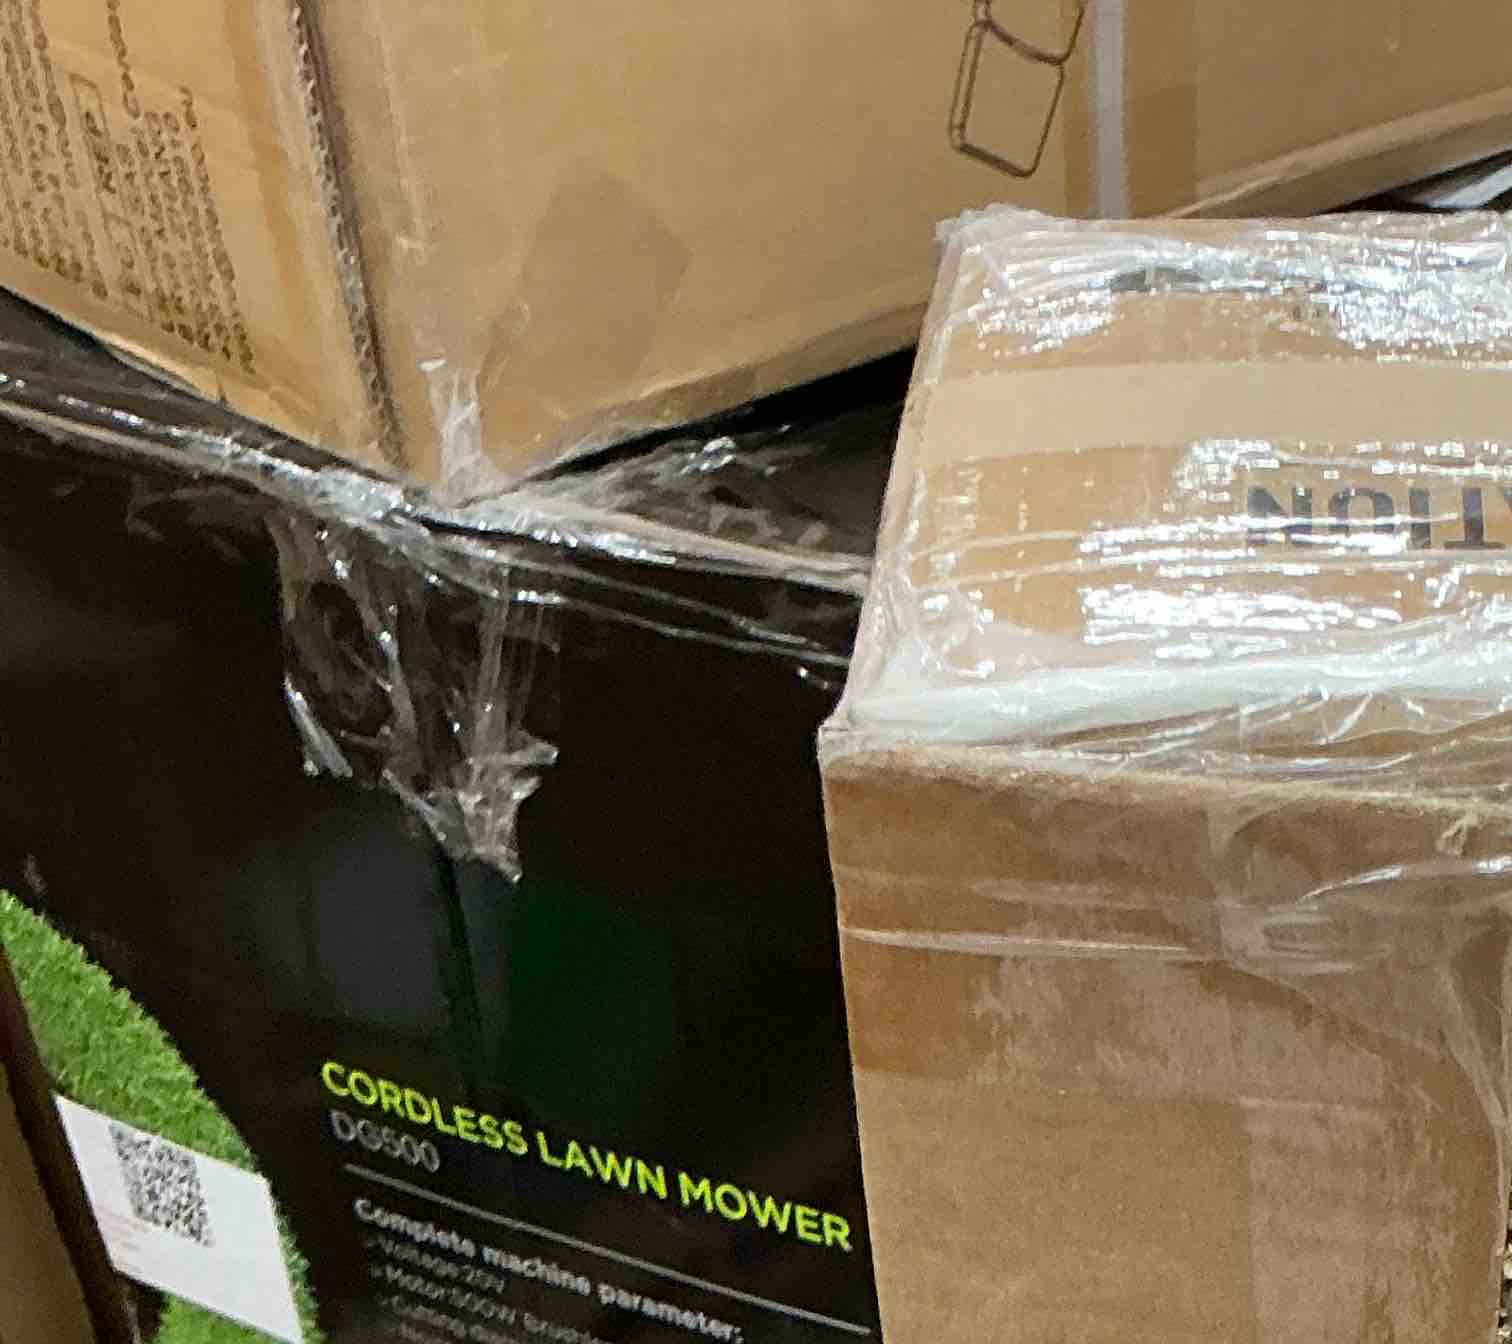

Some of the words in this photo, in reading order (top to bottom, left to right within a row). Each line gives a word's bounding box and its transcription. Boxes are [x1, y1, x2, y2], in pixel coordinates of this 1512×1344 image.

[321, 1061, 528, 1155] CORDLESS
[536, 1131, 667, 1199] LAWN
[677, 1172, 852, 1251] MOWER
[353, 1199, 475, 1258] Complete
[483, 1245, 591, 1296] machine
[598, 1284, 744, 1344] parameter:
